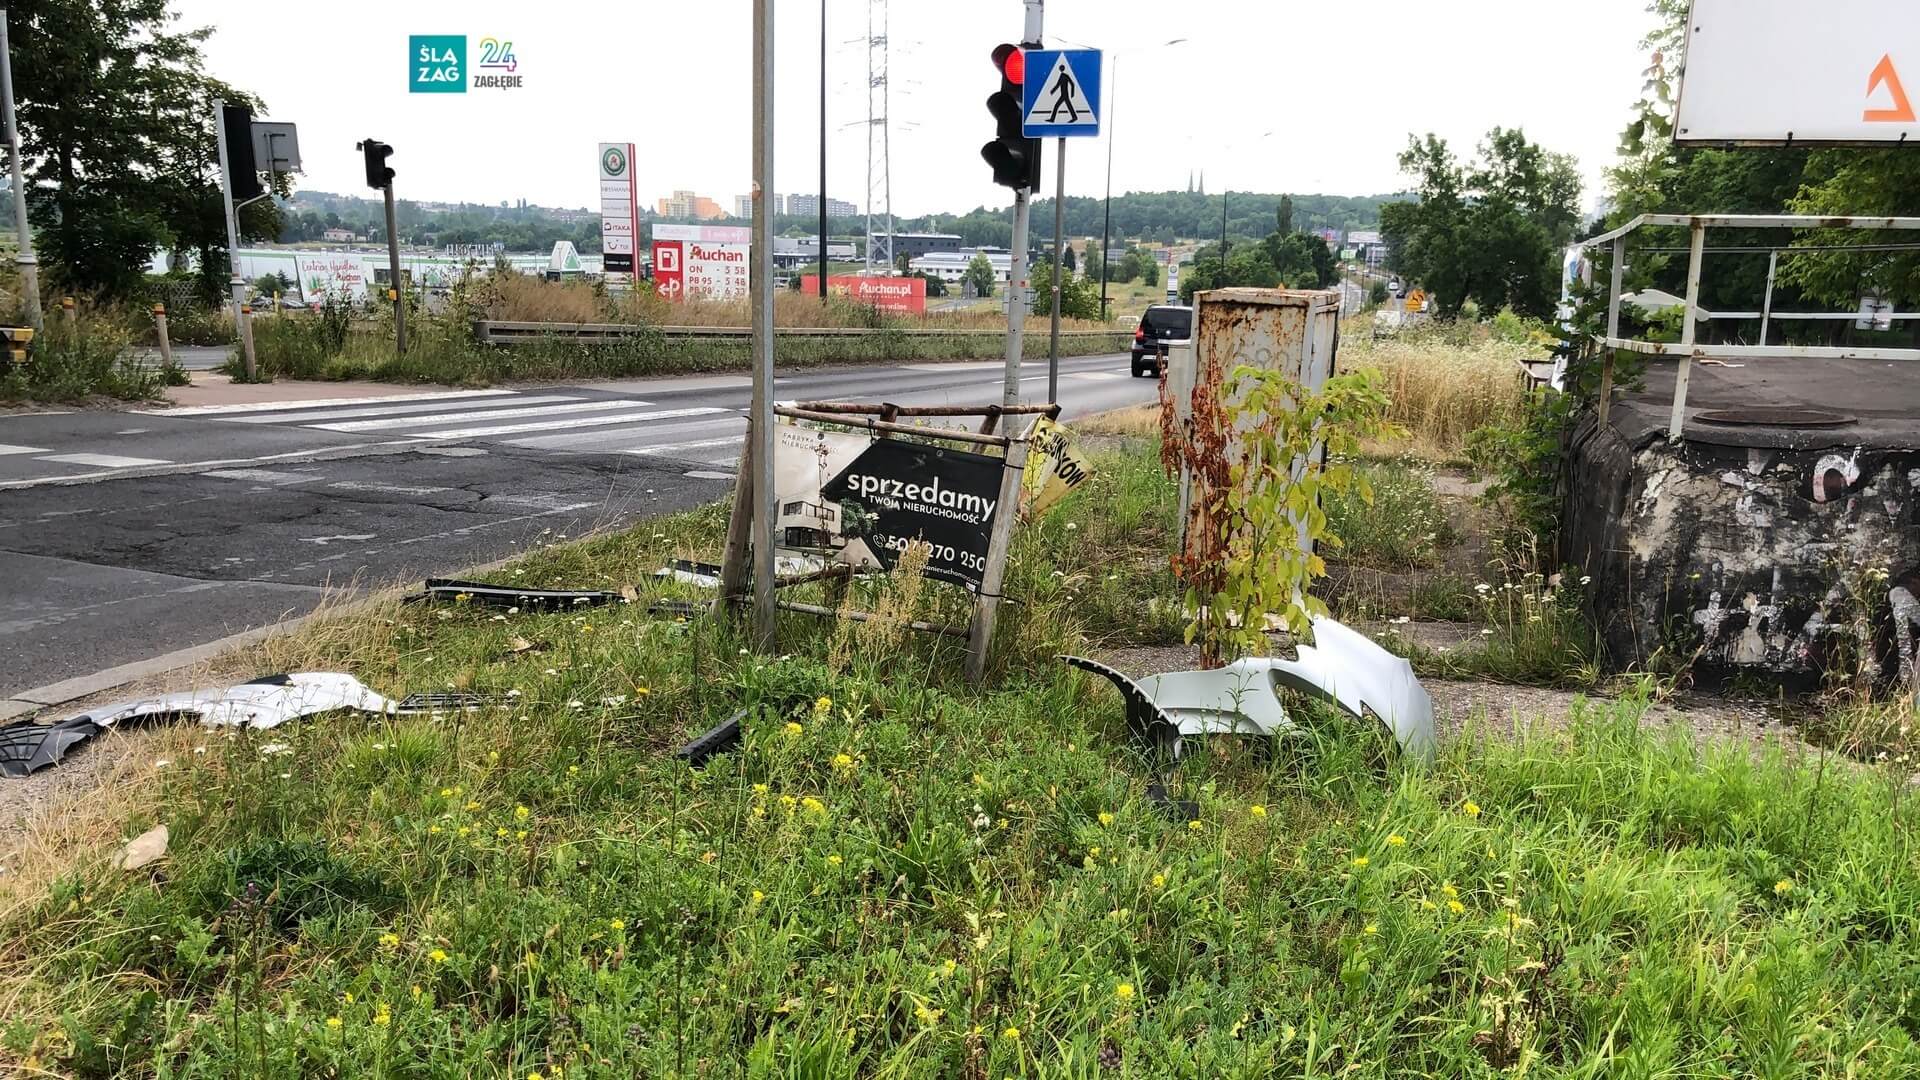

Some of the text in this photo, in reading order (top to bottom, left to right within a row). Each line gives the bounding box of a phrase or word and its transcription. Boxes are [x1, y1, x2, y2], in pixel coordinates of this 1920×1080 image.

[689, 246, 744, 262] Auchan
[688, 265, 703, 273] ON
[688, 276, 700, 284] PB
[701, 277, 713, 285] 95
[859, 281, 912, 297] Auchan.pl
[847, 473, 996, 523] sprzedamy
[960, 550, 986, 572] 250
